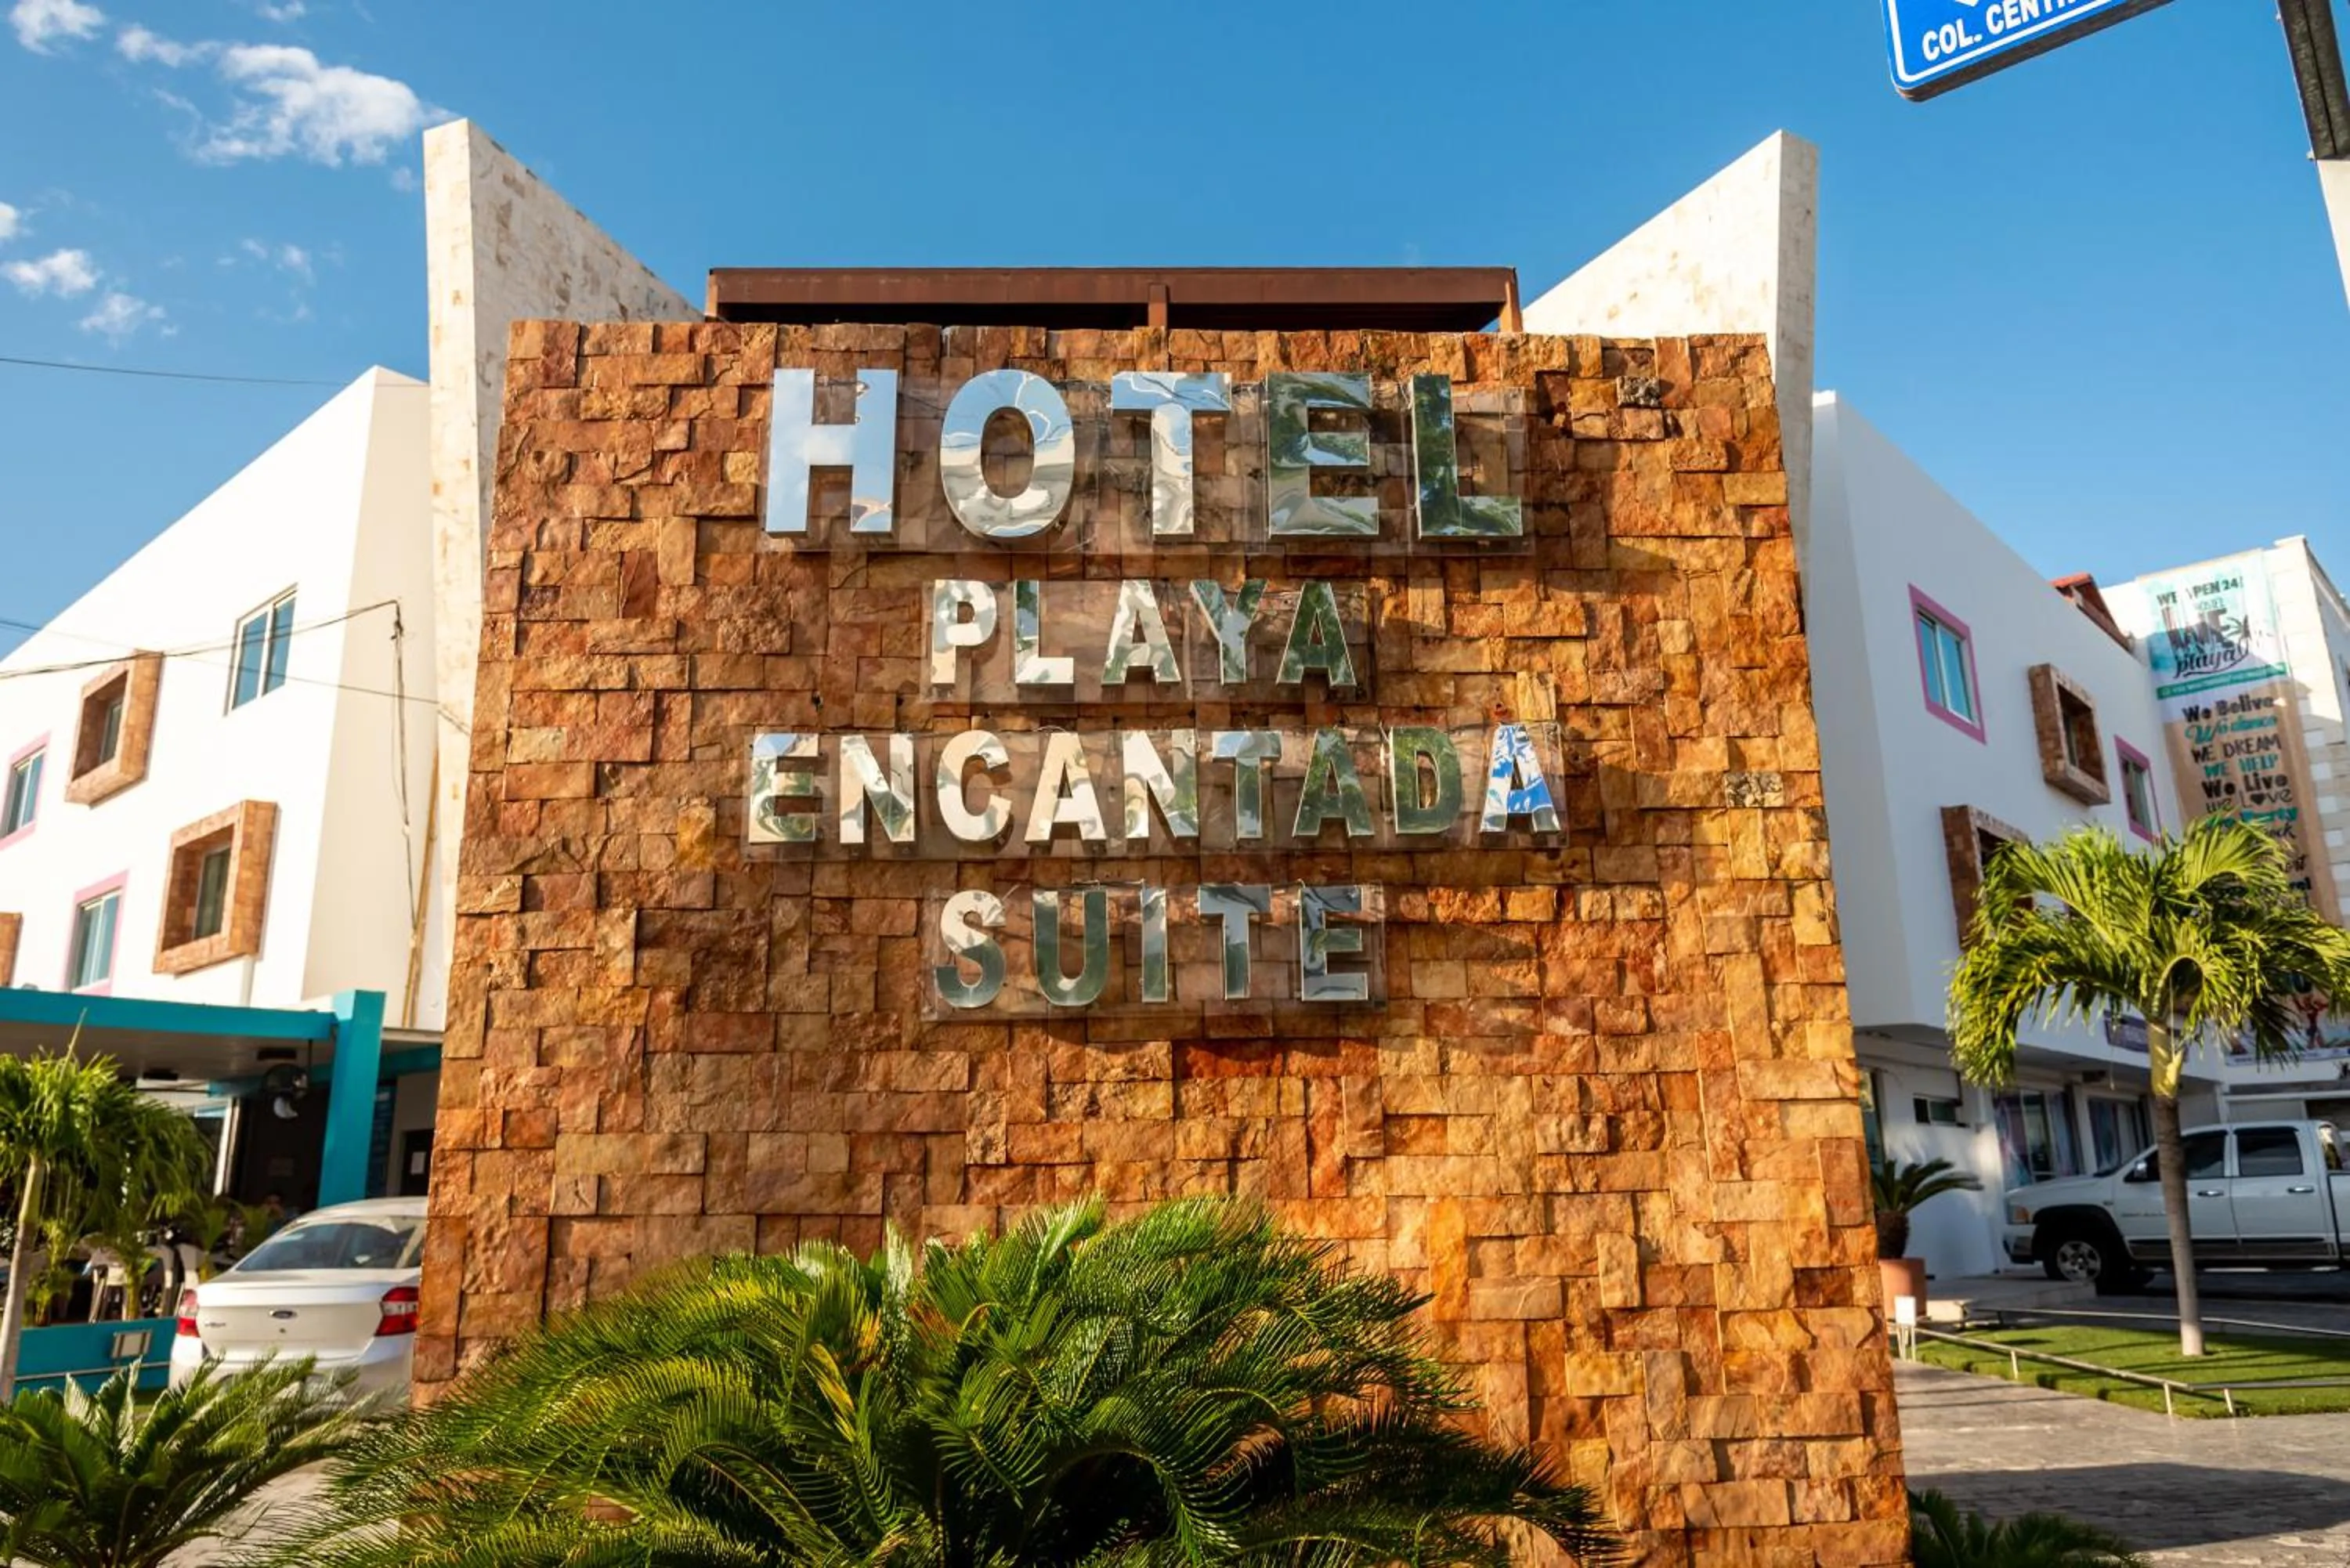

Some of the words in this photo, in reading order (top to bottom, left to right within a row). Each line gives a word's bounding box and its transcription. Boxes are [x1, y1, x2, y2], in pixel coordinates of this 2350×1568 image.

[1922, 19, 1983, 61] COL.
[765, 368, 1524, 540] HOTEL
[930, 578, 1359, 688] PLAYA
[2182, 705, 2211, 722] We
[2222, 734, 2283, 759] DREAM
[2239, 753, 2279, 773] HELP
[748, 722, 1563, 847] ENCANTADA
[2201, 779, 2236, 798] We
[2243, 771, 2289, 792] Live
[935, 884, 1370, 1010] SUITE
